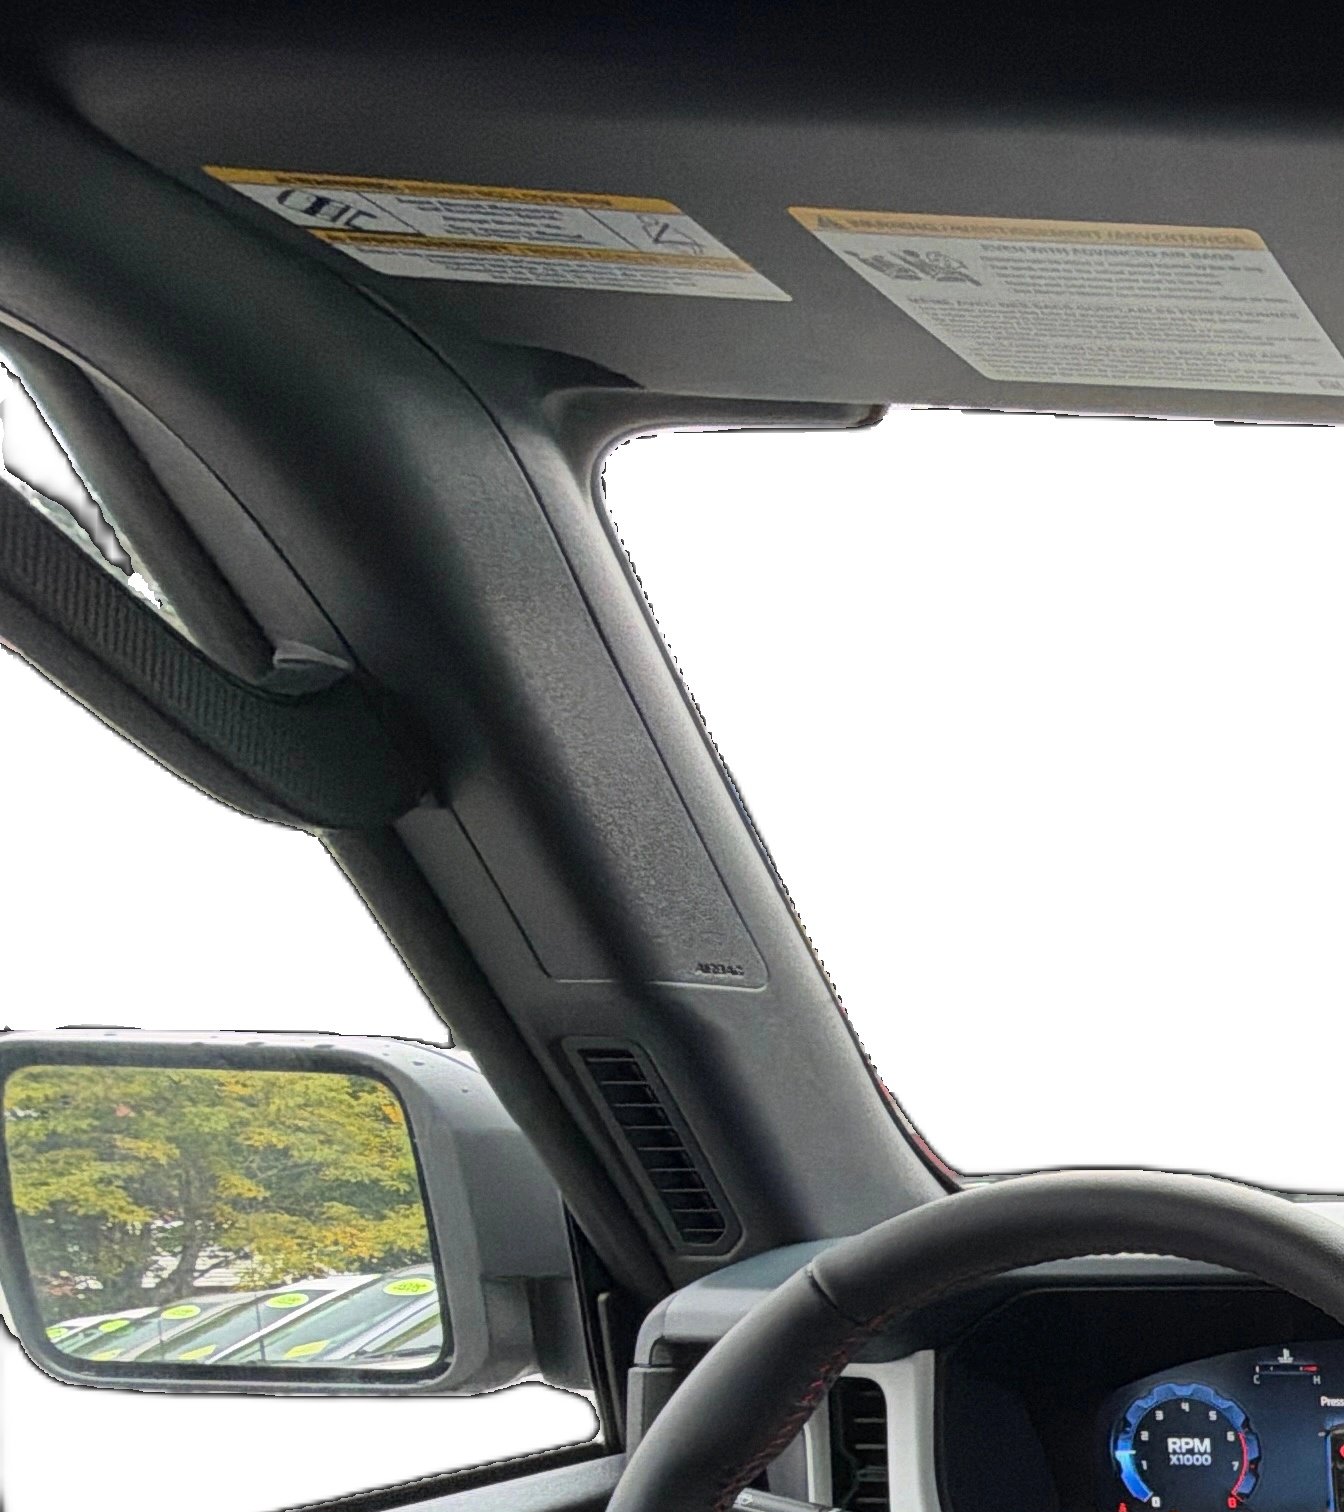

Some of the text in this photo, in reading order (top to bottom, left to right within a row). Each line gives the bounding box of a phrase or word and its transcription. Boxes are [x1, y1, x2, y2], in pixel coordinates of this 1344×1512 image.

[1253, 1375, 1321, 1385] C H
[1320, 1396, 1344, 1407] Press
[1181, 1402, 1190, 1412] 4
[1155, 1411, 1164, 1421] 3
[1209, 1411, 1217, 1421] 5
[1140, 1431, 1149, 1441] 2
[1226, 1431, 1235, 1442] 6
[1167, 1438, 1211, 1453] RPM
[1169, 1454, 1211, 1466] X1000
[1142, 1461, 1148, 1471] 1
[1232, 1461, 1239, 1471] 7
